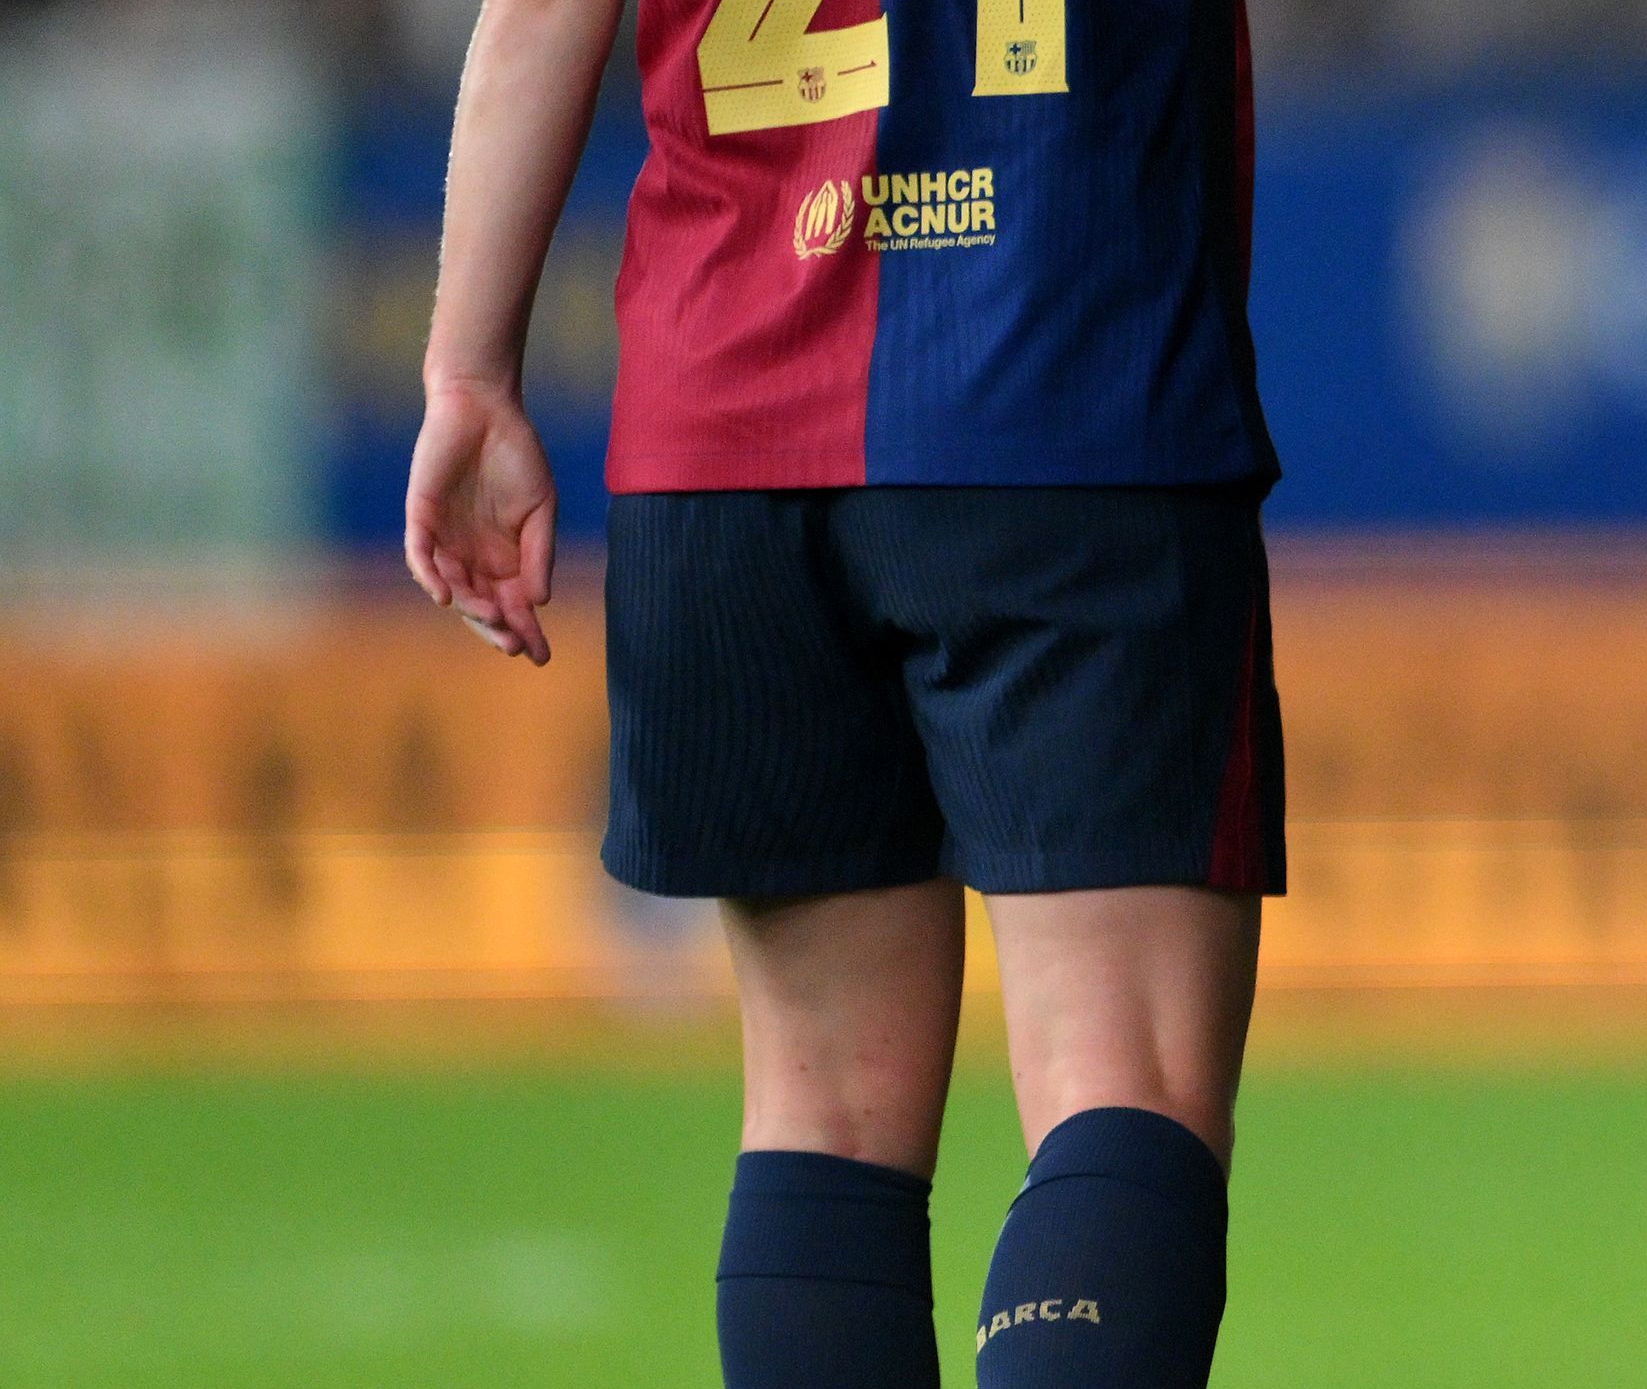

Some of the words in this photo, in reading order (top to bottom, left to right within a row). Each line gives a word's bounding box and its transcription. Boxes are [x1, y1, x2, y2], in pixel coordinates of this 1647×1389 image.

[861, 167, 995, 205] UNHCR
[864, 200, 995, 237] ACNUR
[865, 240, 888, 251] The
[890, 239, 908, 250] UN
[909, 236, 955, 250] Refugee
[956, 234, 996, 247] Agency
